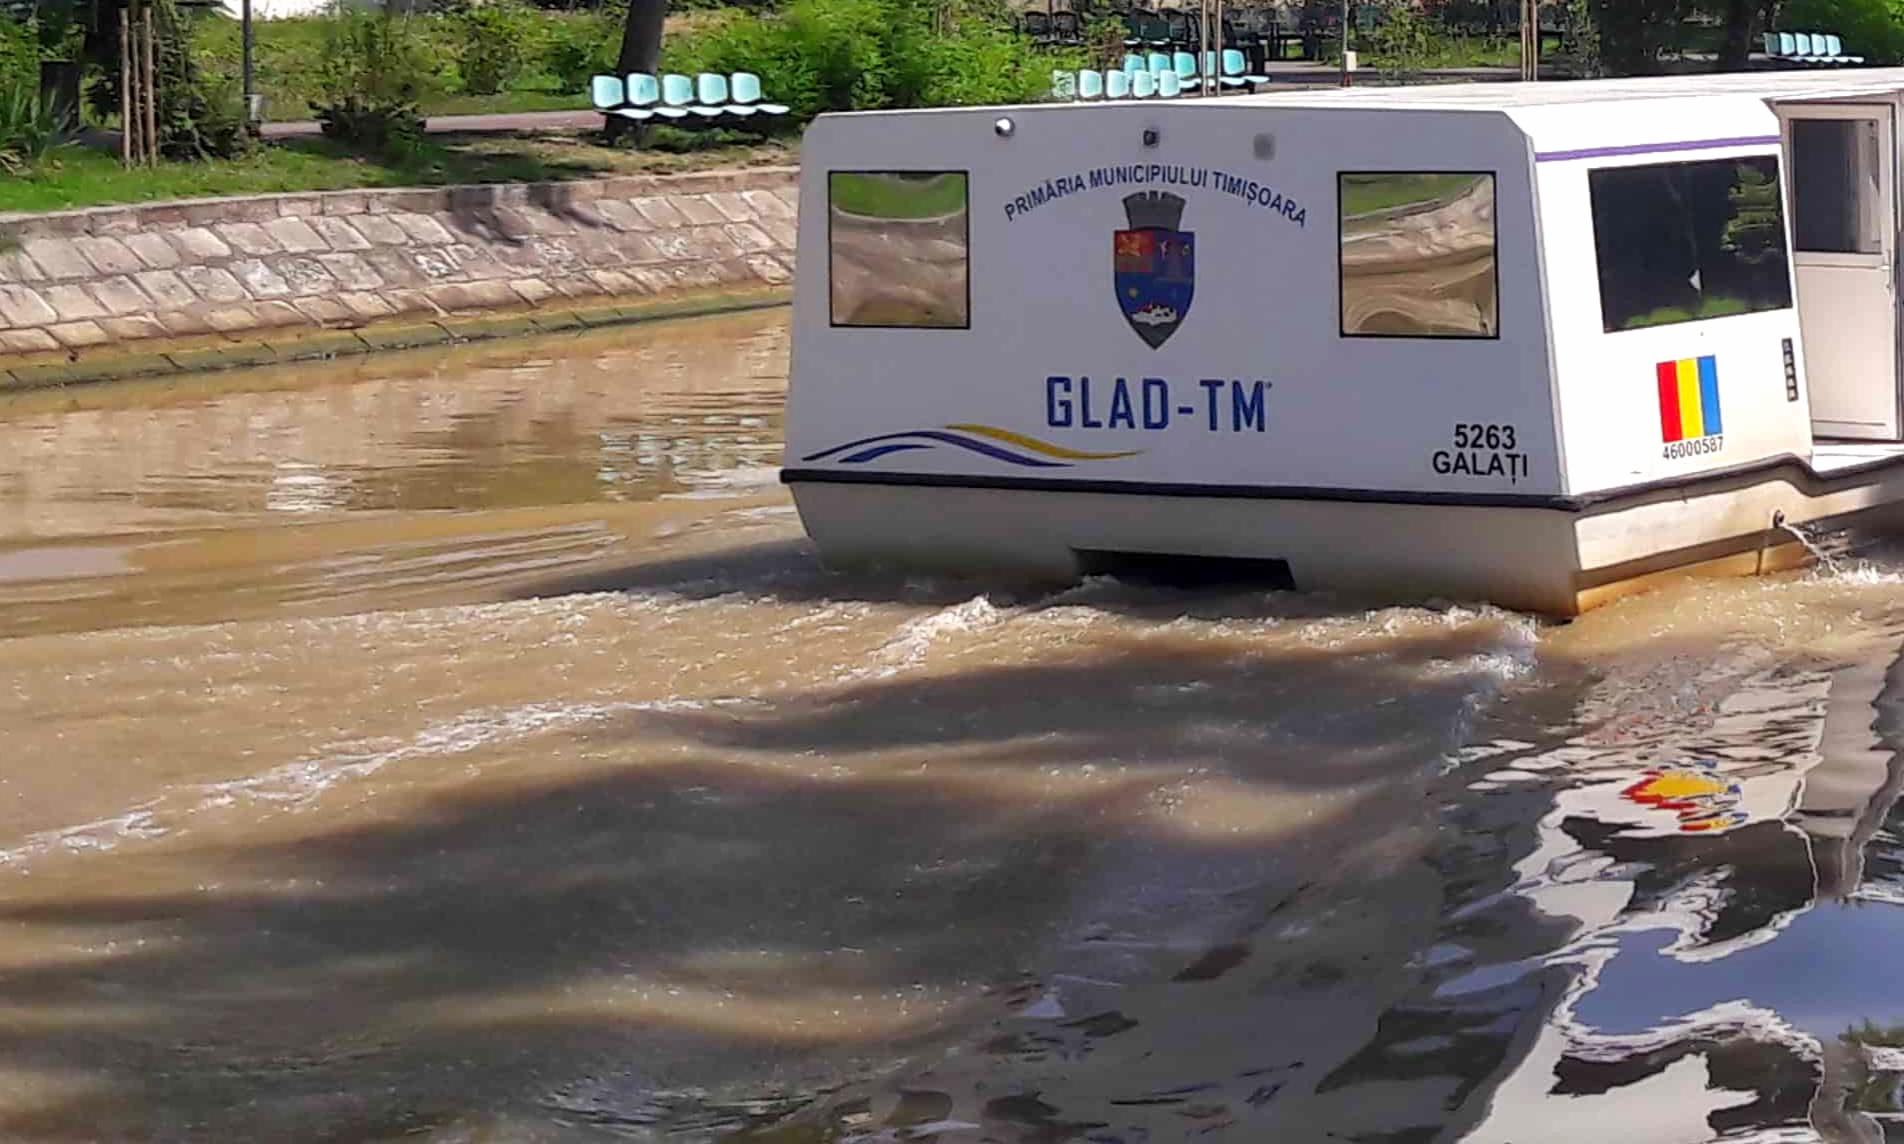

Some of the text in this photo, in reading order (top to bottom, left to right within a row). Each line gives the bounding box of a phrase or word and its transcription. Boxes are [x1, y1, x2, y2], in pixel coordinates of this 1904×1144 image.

[1090, 164, 1207, 189] MUNICIPIULUI
[1455, 424, 1516, 450] 5263
[1662, 436, 1723, 460] 46000587
[1432, 451, 1528, 485] GALAȚI
